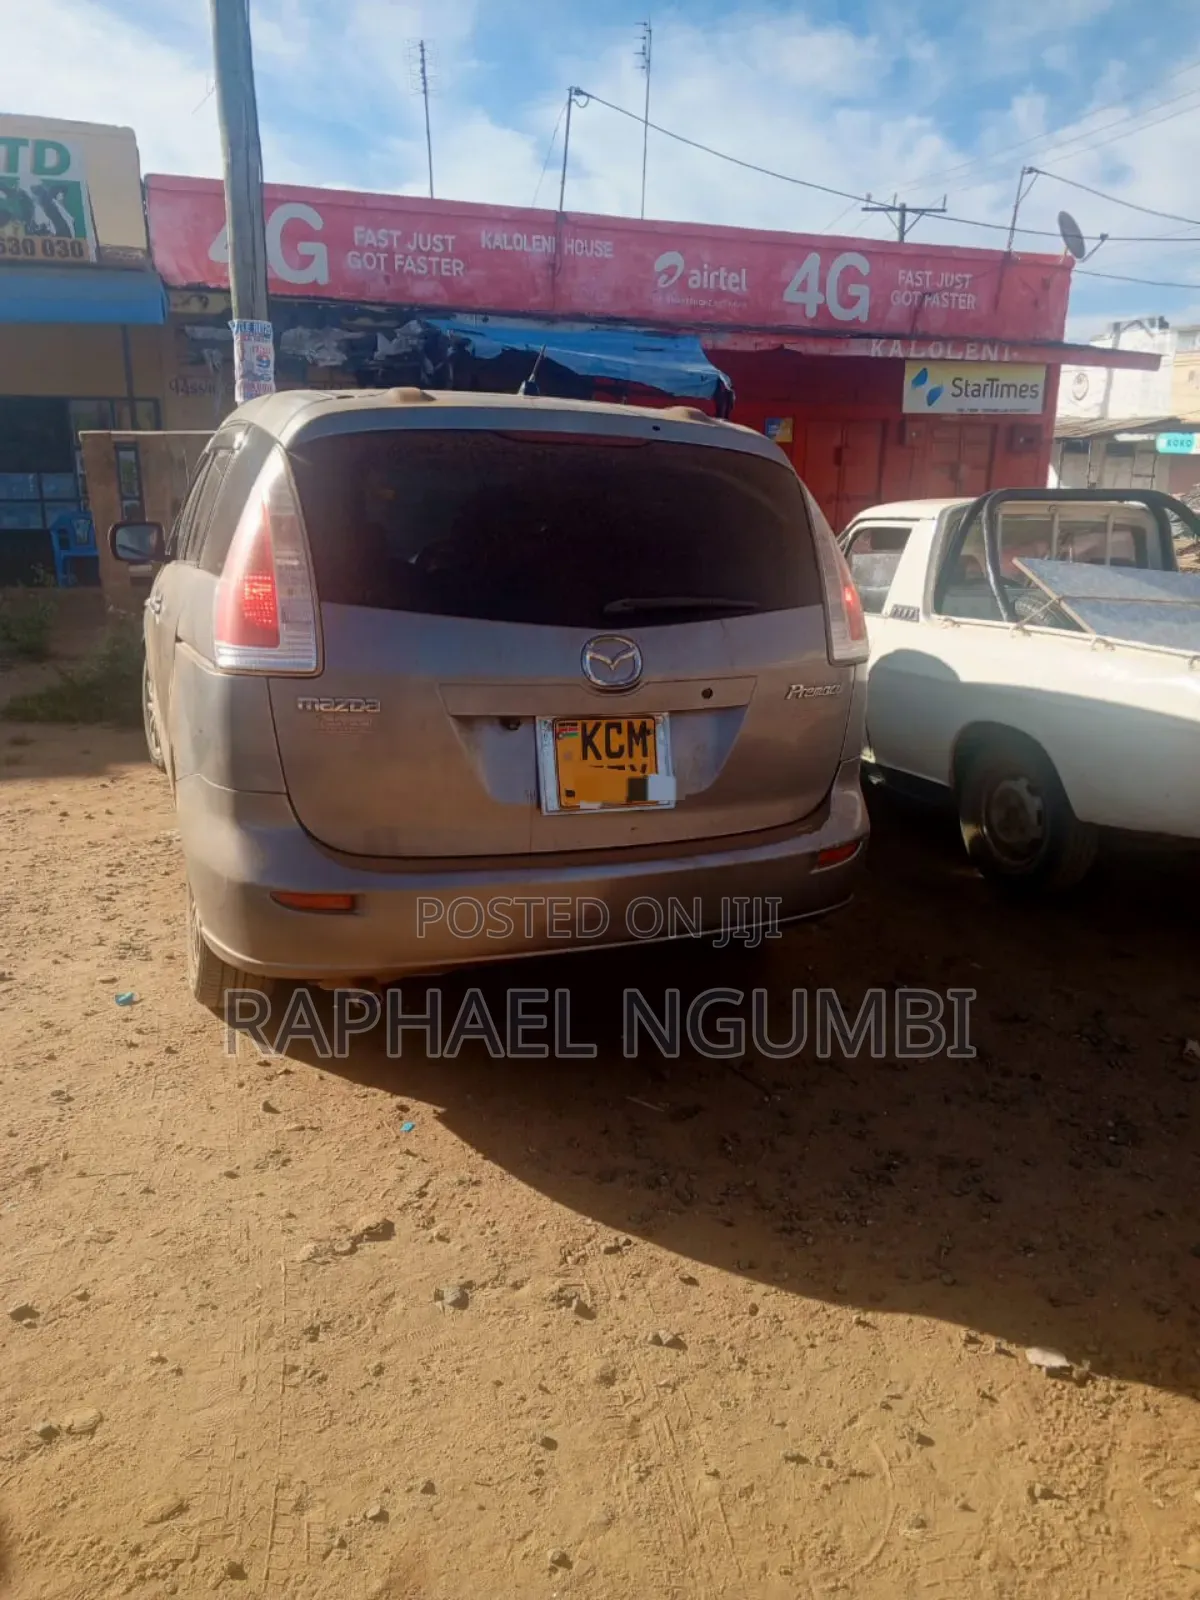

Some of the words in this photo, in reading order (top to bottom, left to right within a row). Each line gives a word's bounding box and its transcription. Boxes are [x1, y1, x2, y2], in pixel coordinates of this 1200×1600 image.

[354, 226, 401, 249] FAST
[407, 232, 456, 253] JUST
[481, 230, 556, 253] KALOLENI
[564, 238, 614, 258] HOUSE
[347, 250, 388, 271] GOT
[394, 254, 464, 277] FASTER
[687, 263, 748, 293] airtel
[783, 252, 870, 323] 4G
[898, 269, 932, 289] FAST
[937, 272, 973, 289] JUST
[890, 290, 921, 307] GOT
[924, 291, 976, 310] FASTER
[870, 339, 1012, 361] KALOLENI
[950, 376, 1040, 400] StarTimes
[581, 720, 650, 761] KCM
